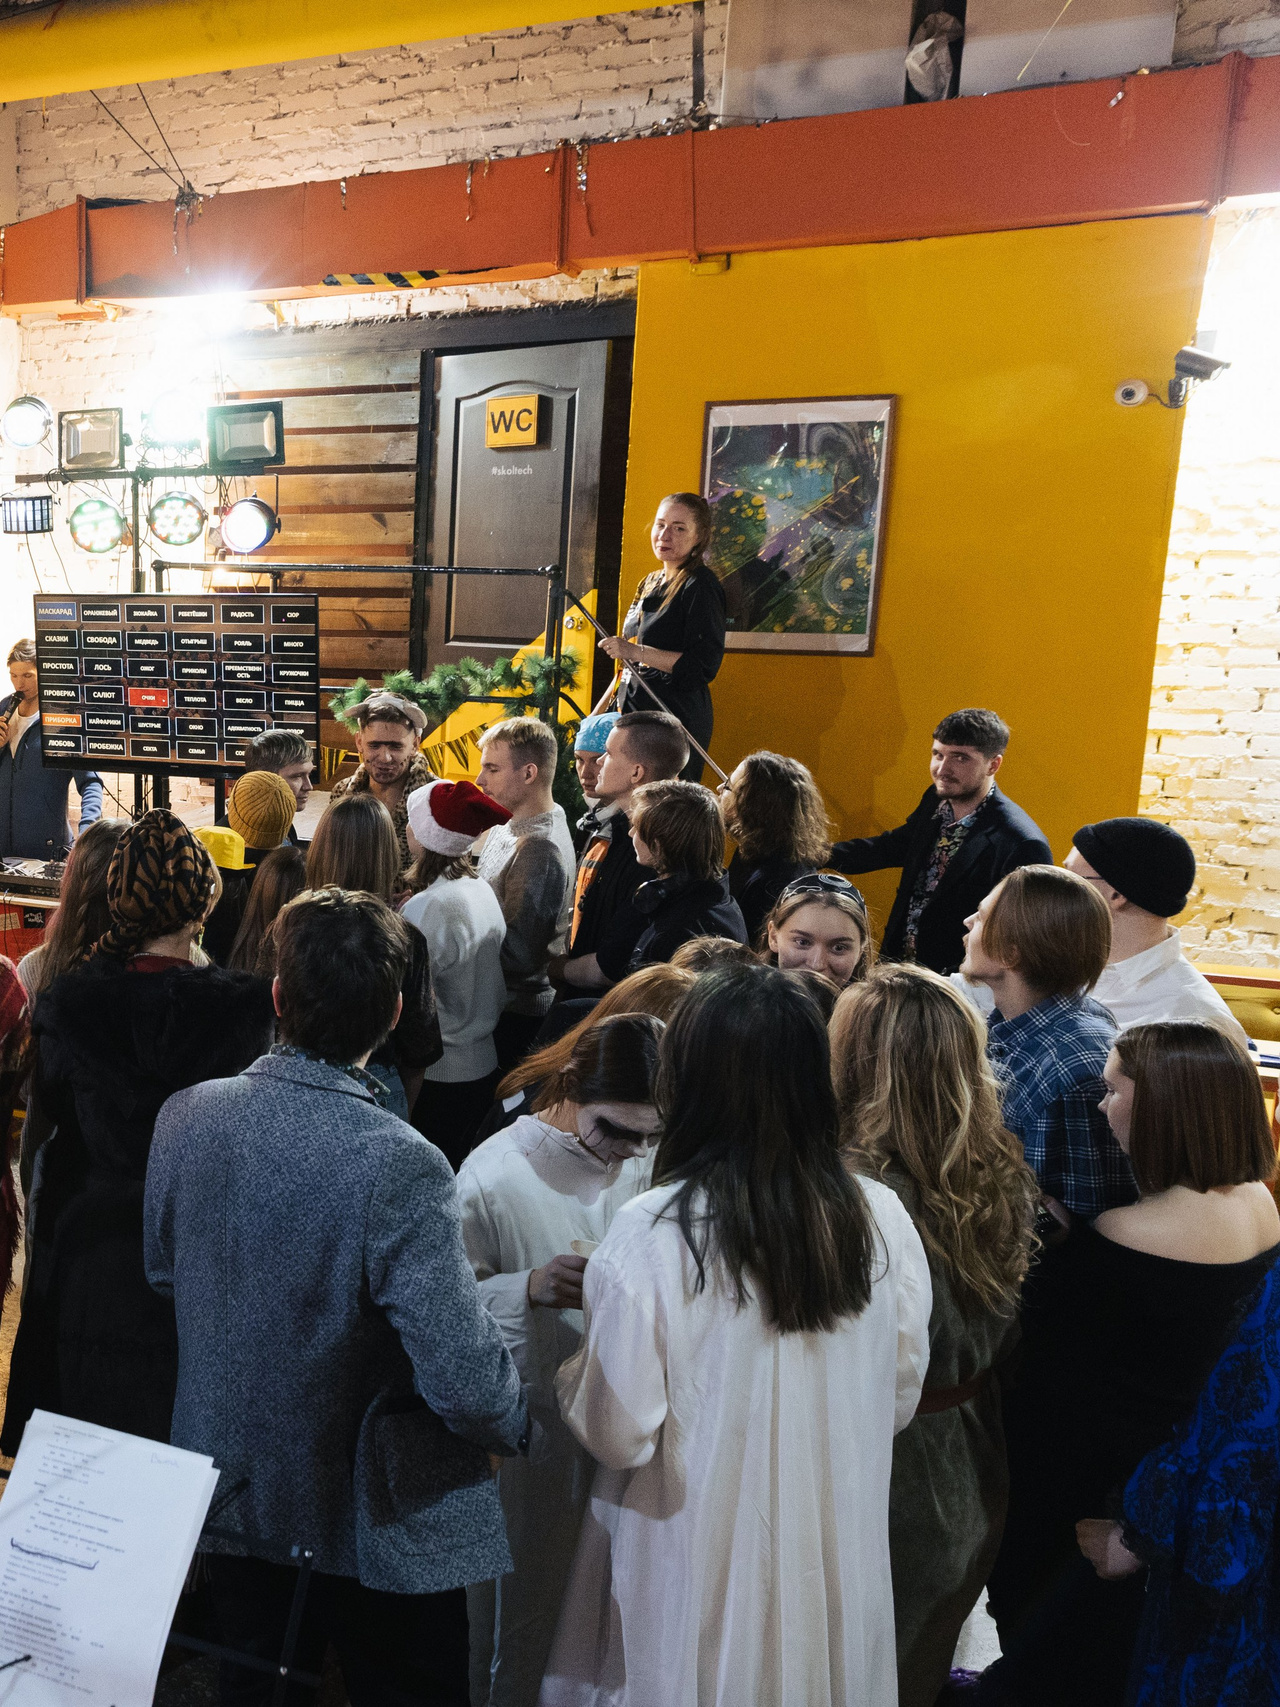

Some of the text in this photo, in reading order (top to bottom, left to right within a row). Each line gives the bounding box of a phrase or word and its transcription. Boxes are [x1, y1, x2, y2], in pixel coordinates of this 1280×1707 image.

[490, 408, 533, 434] WC
[491, 464, 533, 475] #skoltech
[38, 608, 73, 616] МАСКАРАД
[83, 609, 118, 617] ОРАНЖЕВЫЙ
[86, 636, 117, 644] СВОБОДА
[43, 689, 76, 697] ПРОВЕРКА
[92, 691, 116, 699] САЛЮТ
[44, 716, 78, 724] ПРИБОРКА
[48, 740, 76, 748] ЛЮБОВЬ
[89, 743, 124, 751] ПРОБЕЖКА
